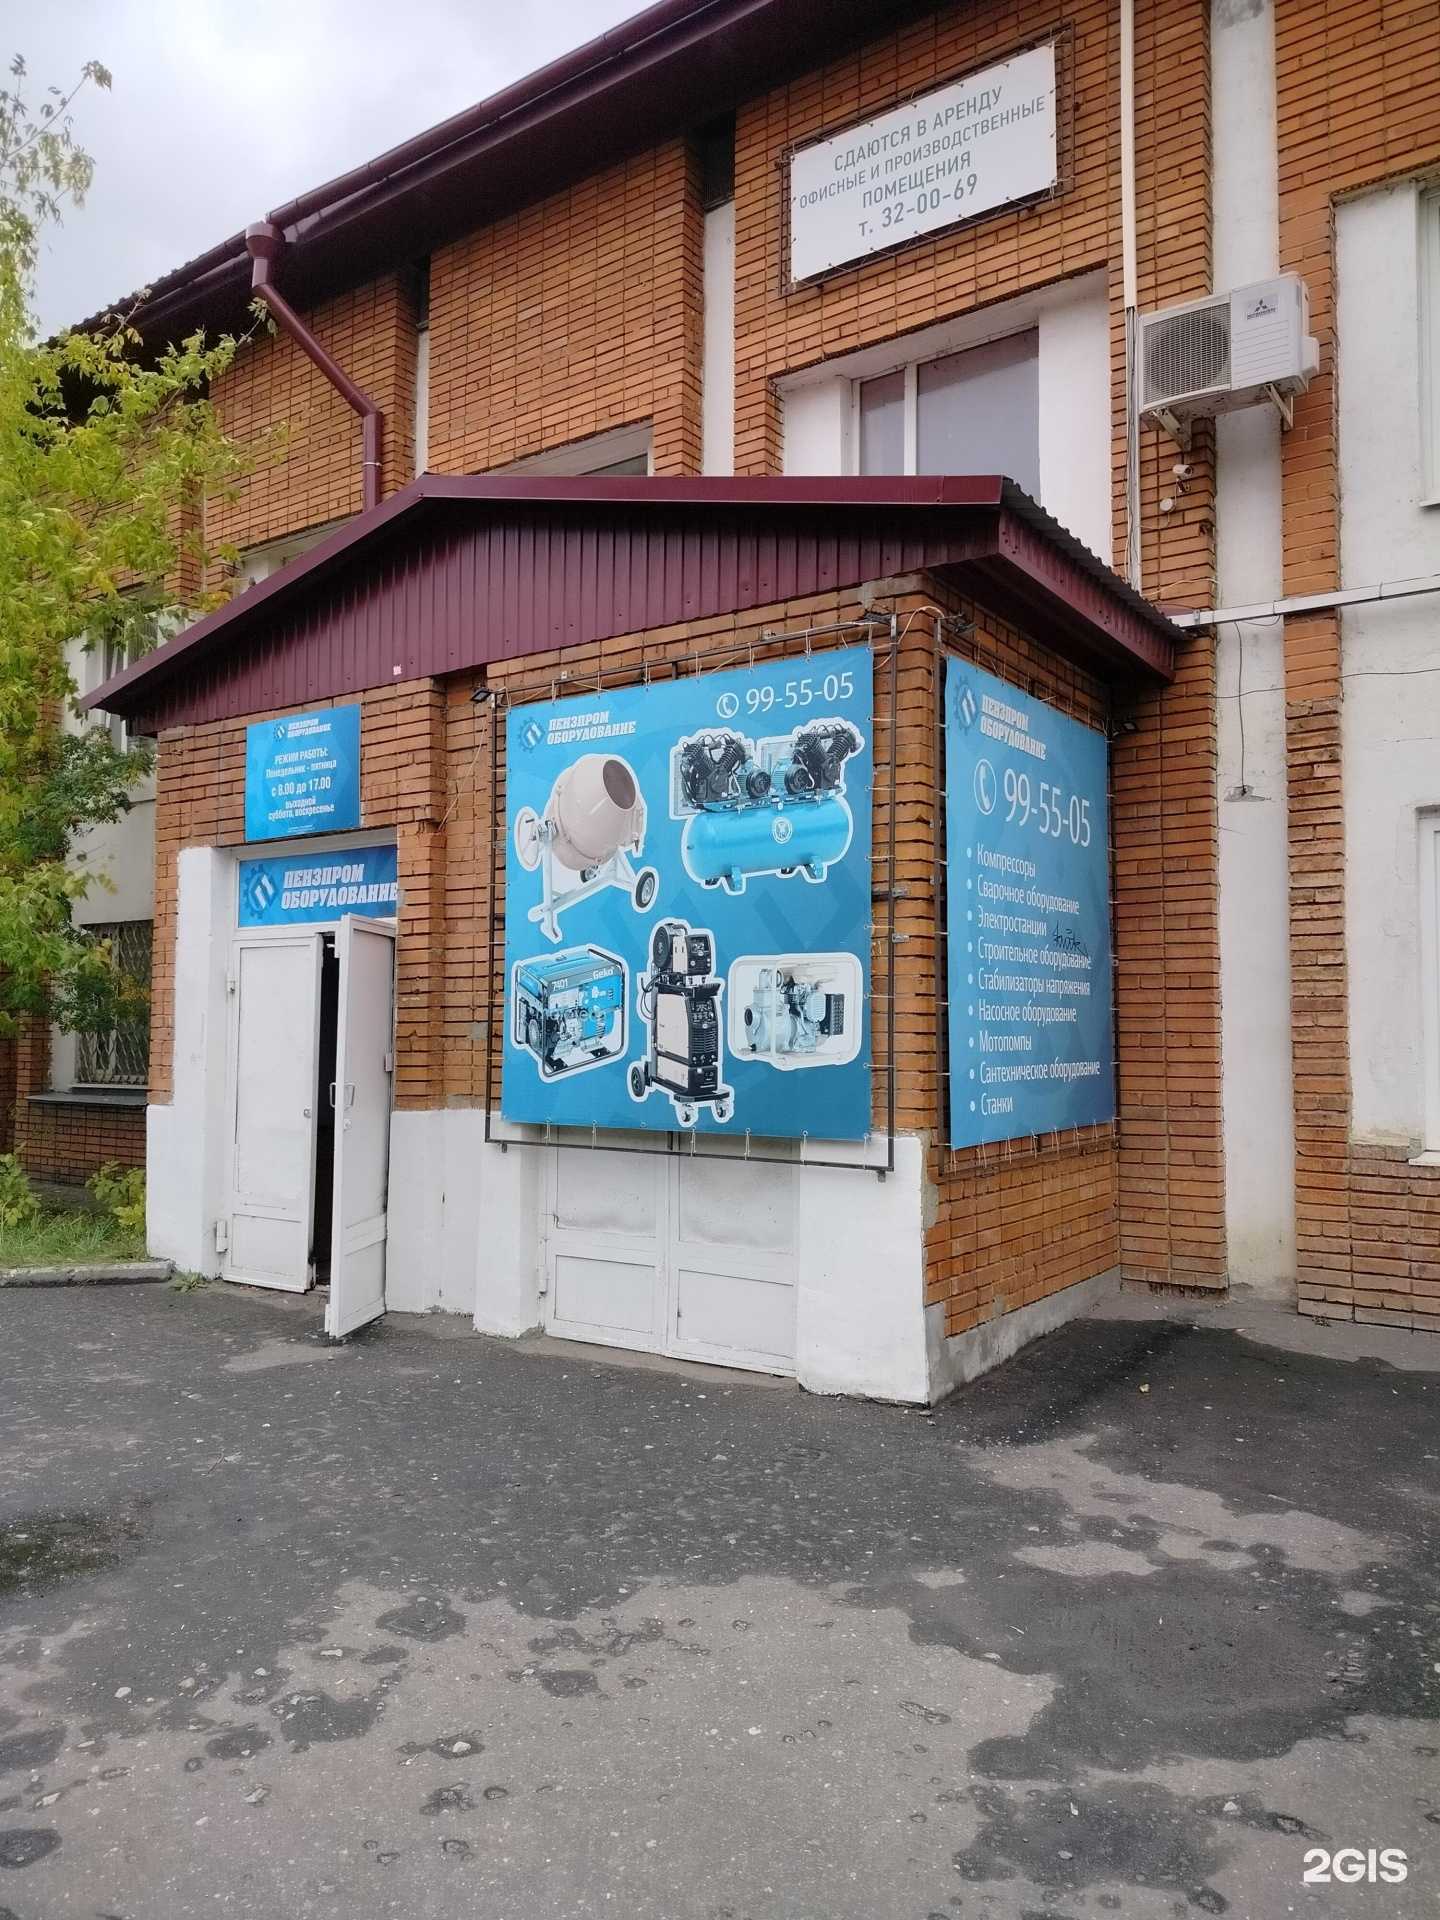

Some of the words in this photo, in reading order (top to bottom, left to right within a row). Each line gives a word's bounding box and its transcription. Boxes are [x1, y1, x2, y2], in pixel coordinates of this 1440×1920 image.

[834, 125, 910, 171] СДАЮТСЯ
[917, 119, 927, 136] В
[933, 86, 1003, 130] АРЕНДУ
[799, 170, 866, 209] ОФИСНЫЕ
[871, 165, 880, 180] И
[885, 96, 1045, 175] ПРОИЗВОДСТВЕННЫЕ
[863, 151, 971, 208] ПОМЕЩЕНИЯ
[882, 173, 978, 228] 32-00-69
[746, 671, 854, 714] 99-55-05
[547, 721, 636, 744] ОБОРУДОВАНИЕ
[549, 711, 609, 731] ПЕНЗПРОМ
[981, 715, 1047, 761] ОБОРУДОВАНИЕ
[296, 783, 307, 794] до
[309, 776, 331, 791] 17.00
[1004, 768, 1090, 847] 99-55-05
[284, 864, 365, 888] ПЕНЗПРОМ
[977, 843, 1036, 881] Компрессоры
[281, 882, 398, 910] ОБОРУДОВАНИЕ
[977, 874, 1024, 905] Сварочное
[1027, 885, 1080, 915] оборудование
[978, 905, 1047, 936] Электростанции
[978, 936, 1038, 965] Строительное
[1040, 944, 1092, 971] оборудование
[978, 967, 1044, 997] Стабилизаторы
[1045, 979, 1090, 999] напряжения
[978, 999, 1020, 1021] Насосное
[1022, 1000, 1077, 1026] оборудование
[979, 1030, 1032, 1053] Мотопомпы
[980, 1061, 1048, 1084] Сантехническое
[1050, 1056, 1100, 1082] оборудование
[981, 1093, 1013, 1115] Станки
